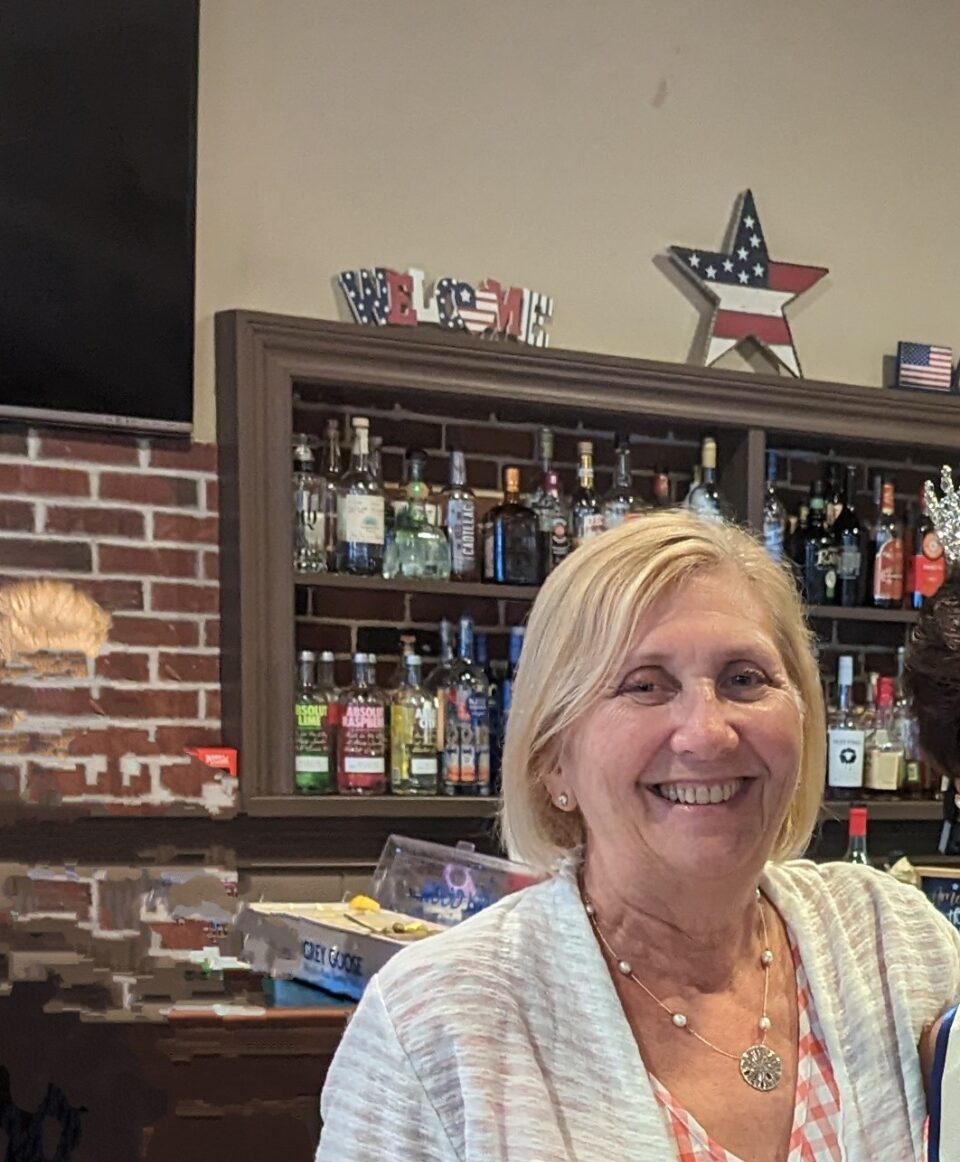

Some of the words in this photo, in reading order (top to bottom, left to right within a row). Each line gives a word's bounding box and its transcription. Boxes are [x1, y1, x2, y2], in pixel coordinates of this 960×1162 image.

[339, 267, 554, 347] WELCOME
[303, 941, 326, 964] GREY
[329, 947, 363, 976] GOOSE
